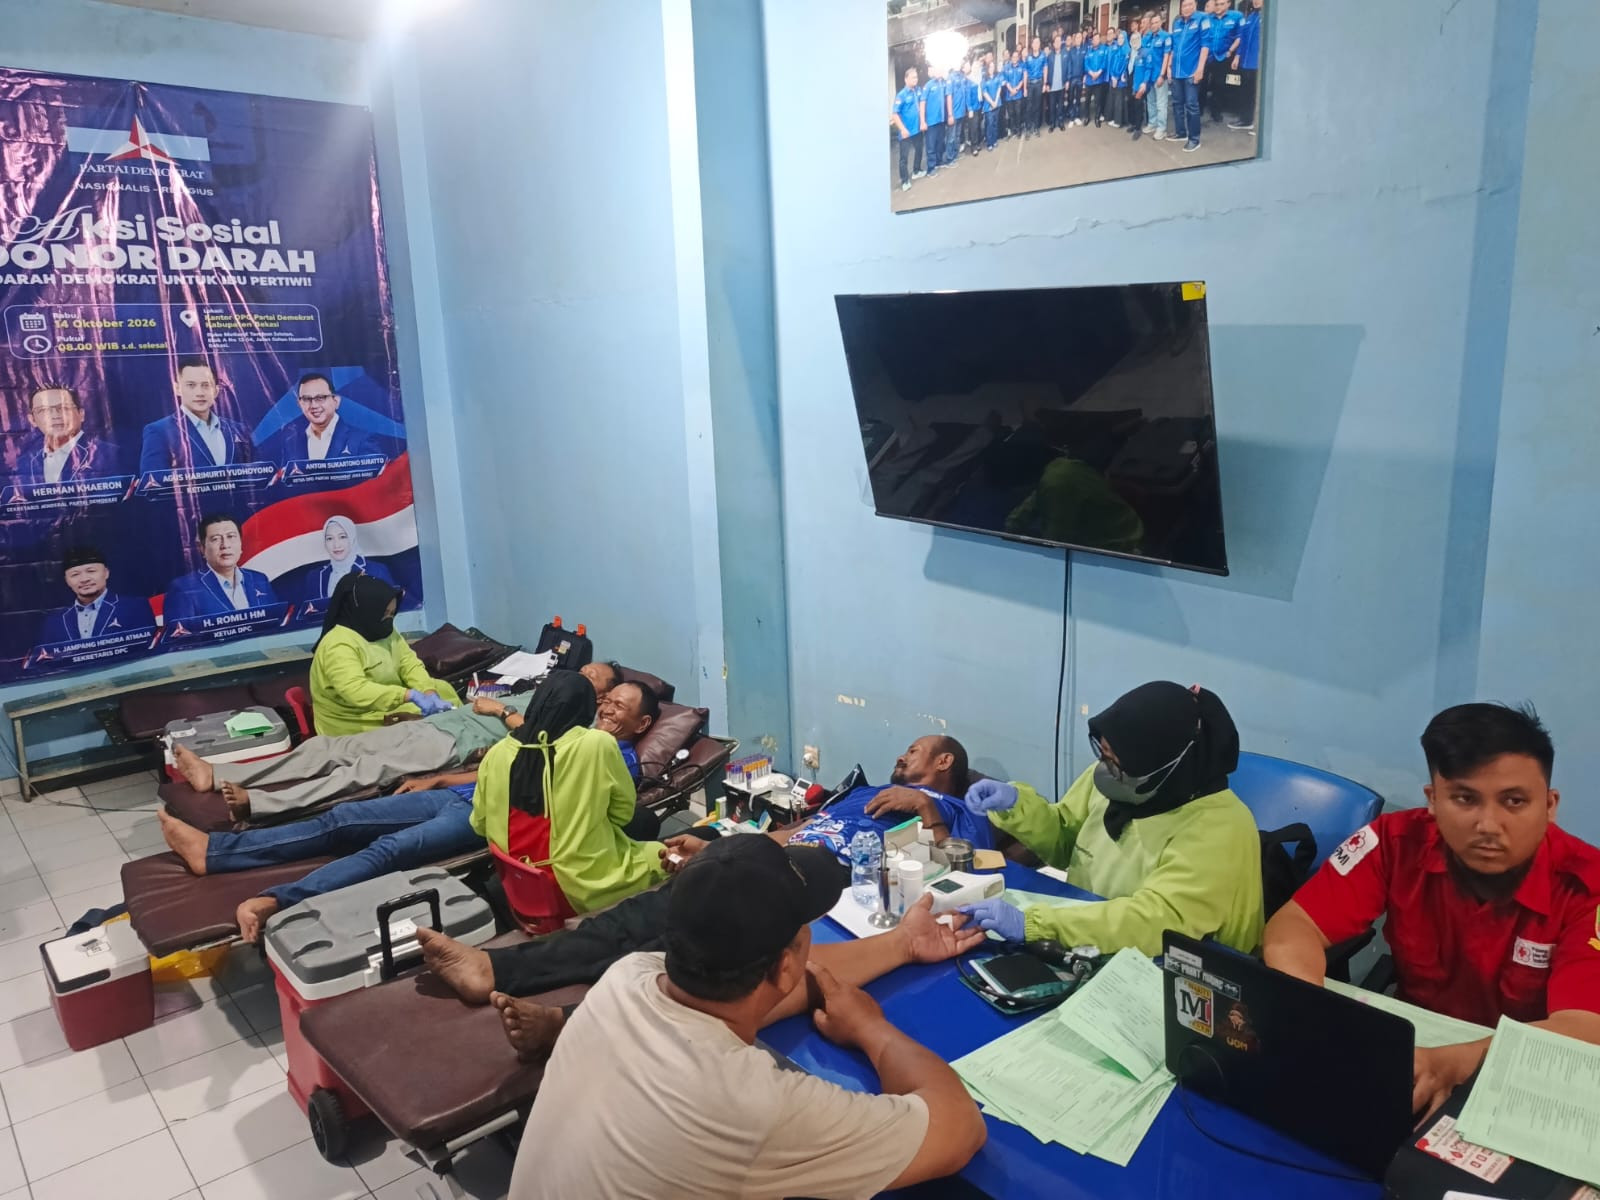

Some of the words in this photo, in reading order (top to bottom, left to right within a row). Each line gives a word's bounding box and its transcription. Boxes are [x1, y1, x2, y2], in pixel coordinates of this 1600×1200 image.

[80, 163, 129, 174] PARTAI
[130, 166, 205, 179] DEMORAT
[1, 205, 148, 243] Aksi
[156, 216, 281, 245] Sosial
[0, 243, 158, 270] ONOR
[167, 246, 316, 273] DARAH
[0, 273, 56, 285] ARAH
[62, 273, 157, 285] DEMOKRAT
[163, 274, 218, 286] UNTUK
[250, 276, 312, 287] PERTIWI!
[55, 319, 69, 329] 14
[73, 318, 124, 328] Oktober
[127, 318, 157, 328] 2026
[32, 486, 75, 497] HERMAN
[77, 480, 123, 492] KHAERON
[203, 618, 214, 628] H.
[216, 611, 248, 625] ROMLI
[250, 609, 266, 619] HM
[214, 628, 236, 639] KETUA
[238, 626, 253, 635] DPC
